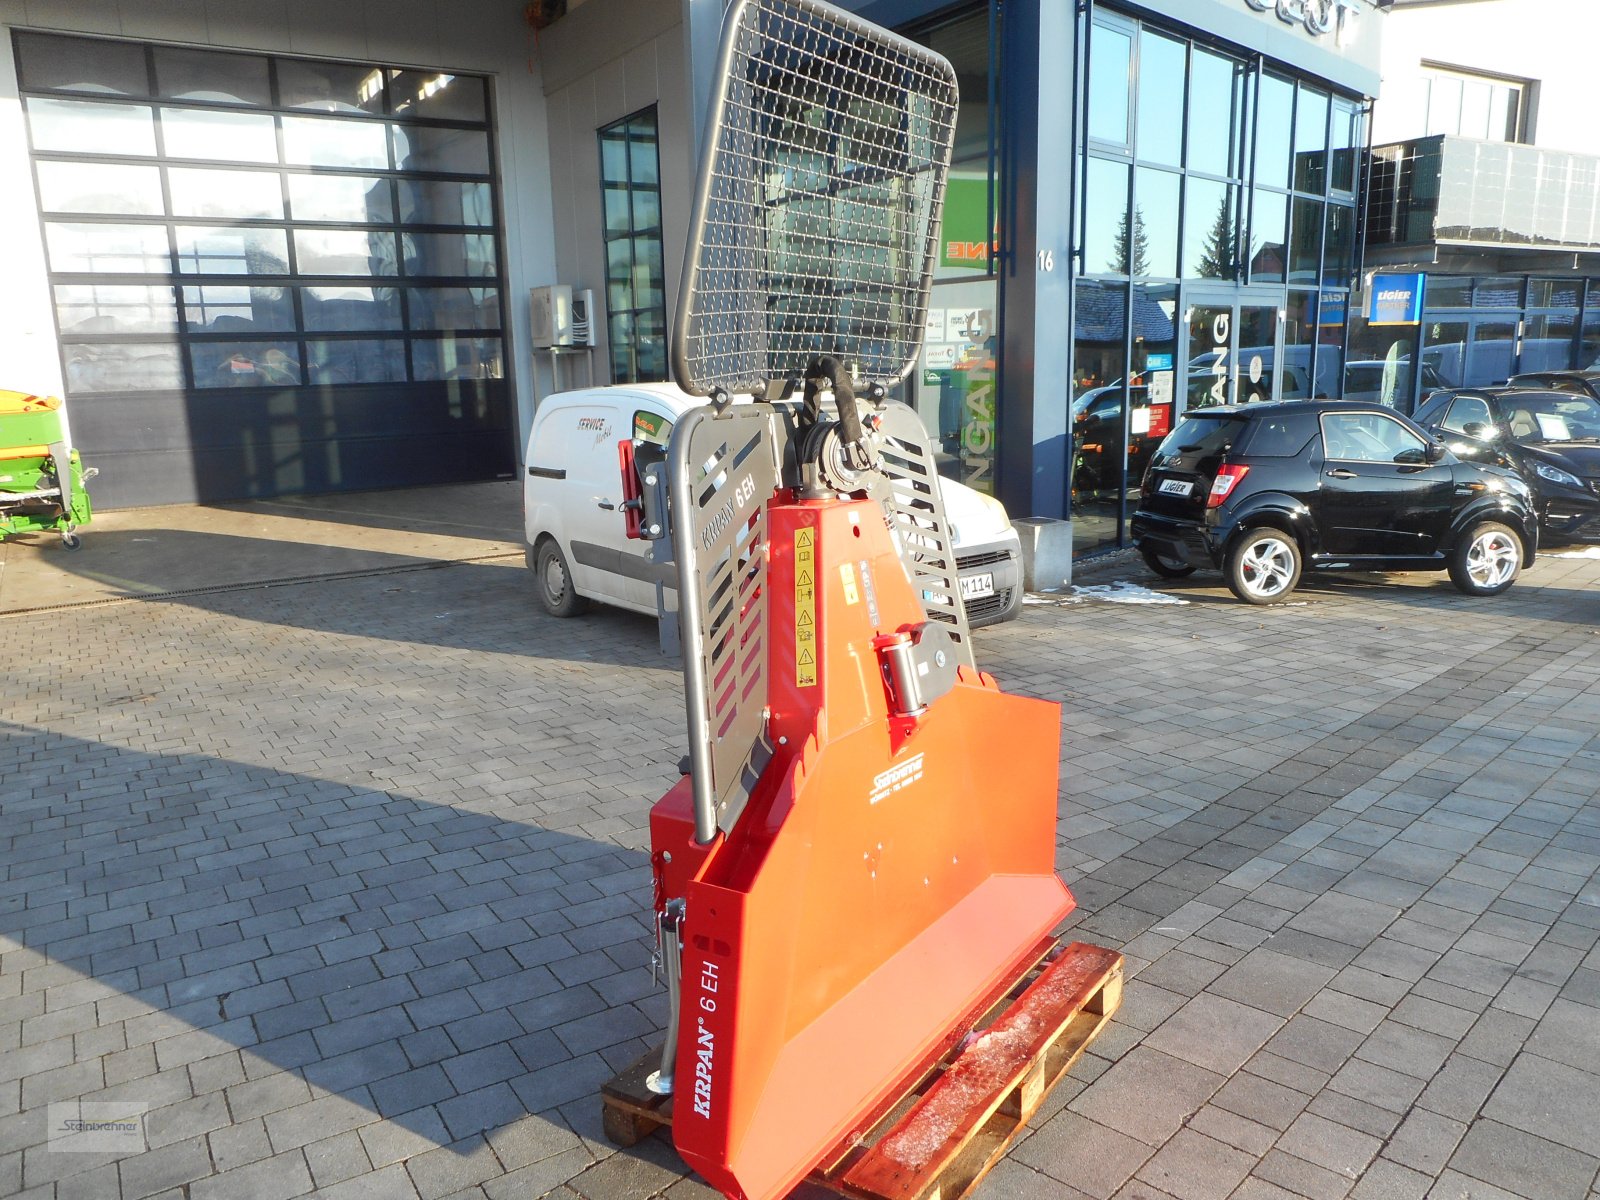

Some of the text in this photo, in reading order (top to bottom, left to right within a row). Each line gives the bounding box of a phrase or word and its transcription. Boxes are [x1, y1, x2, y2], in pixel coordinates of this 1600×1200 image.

[1038, 249, 1053, 271] 16
[1377, 290, 1411, 301] LIGIER
[578, 417, 605, 431] SERVICE
[1164, 482, 1187, 493] LIGIER
[701, 472, 756, 551] KRPAN 6 EH
[971, 576, 991, 593] 114
[701, 960, 719, 993] EH
[700, 996, 717, 1012] 6
